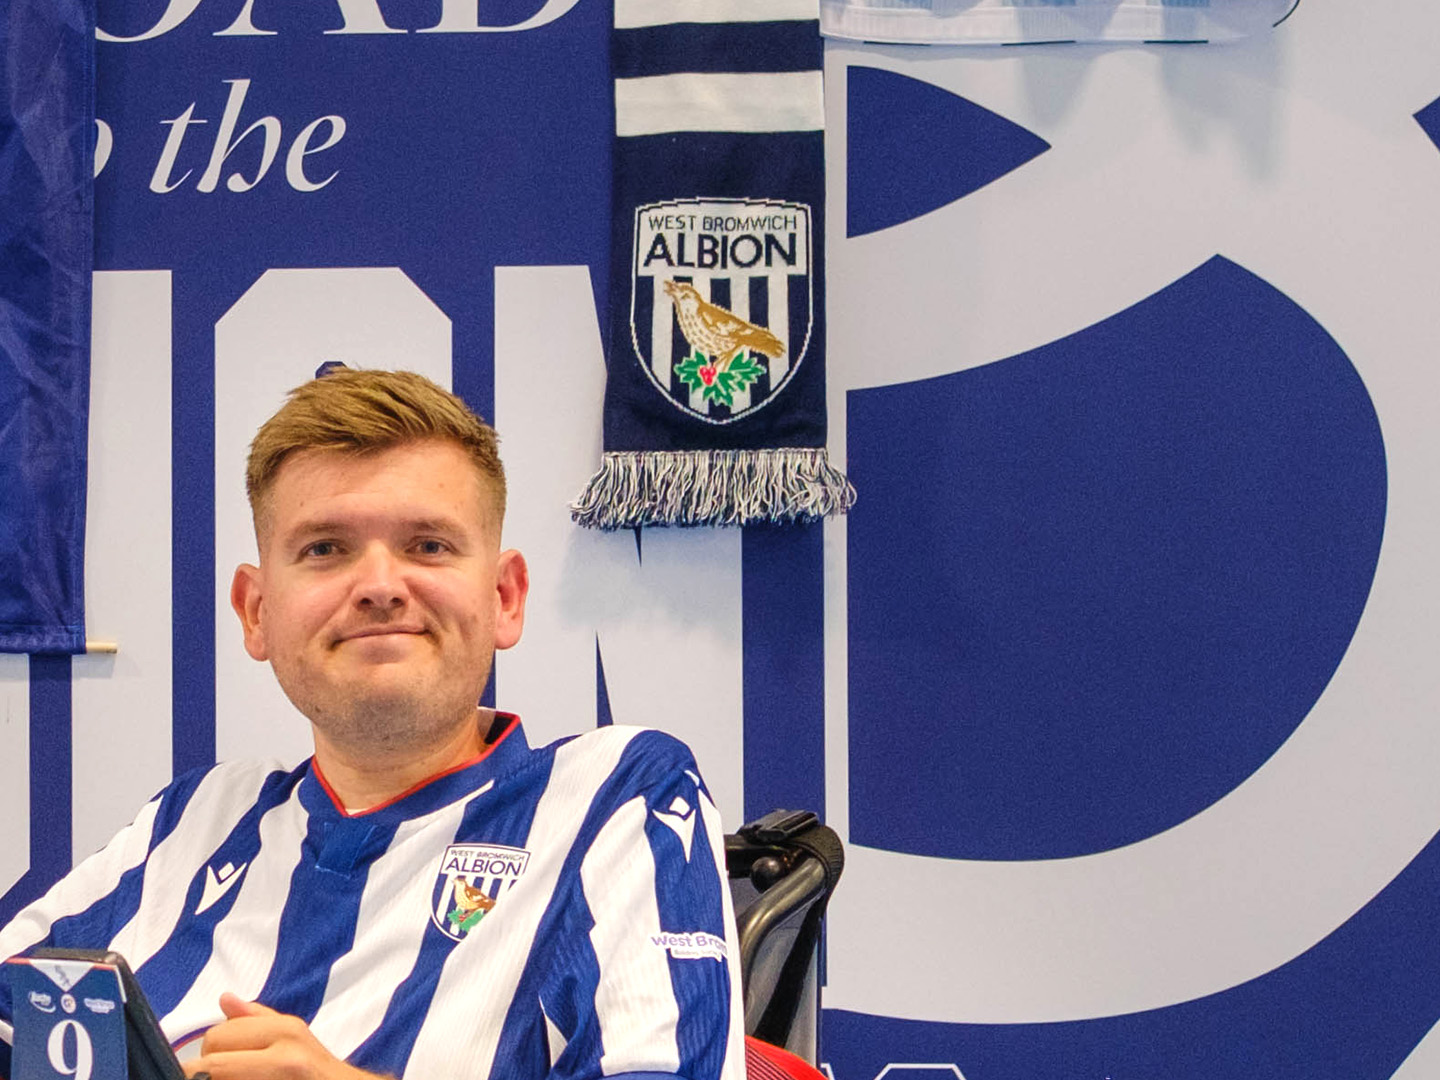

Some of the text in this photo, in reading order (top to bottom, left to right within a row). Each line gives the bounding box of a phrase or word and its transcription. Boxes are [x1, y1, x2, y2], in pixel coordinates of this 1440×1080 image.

[148, 79, 347, 194] the
[648, 214, 798, 232] WEST BROMWICH
[643, 232, 797, 269] ALBION
[445, 857, 522, 876] ALBION
